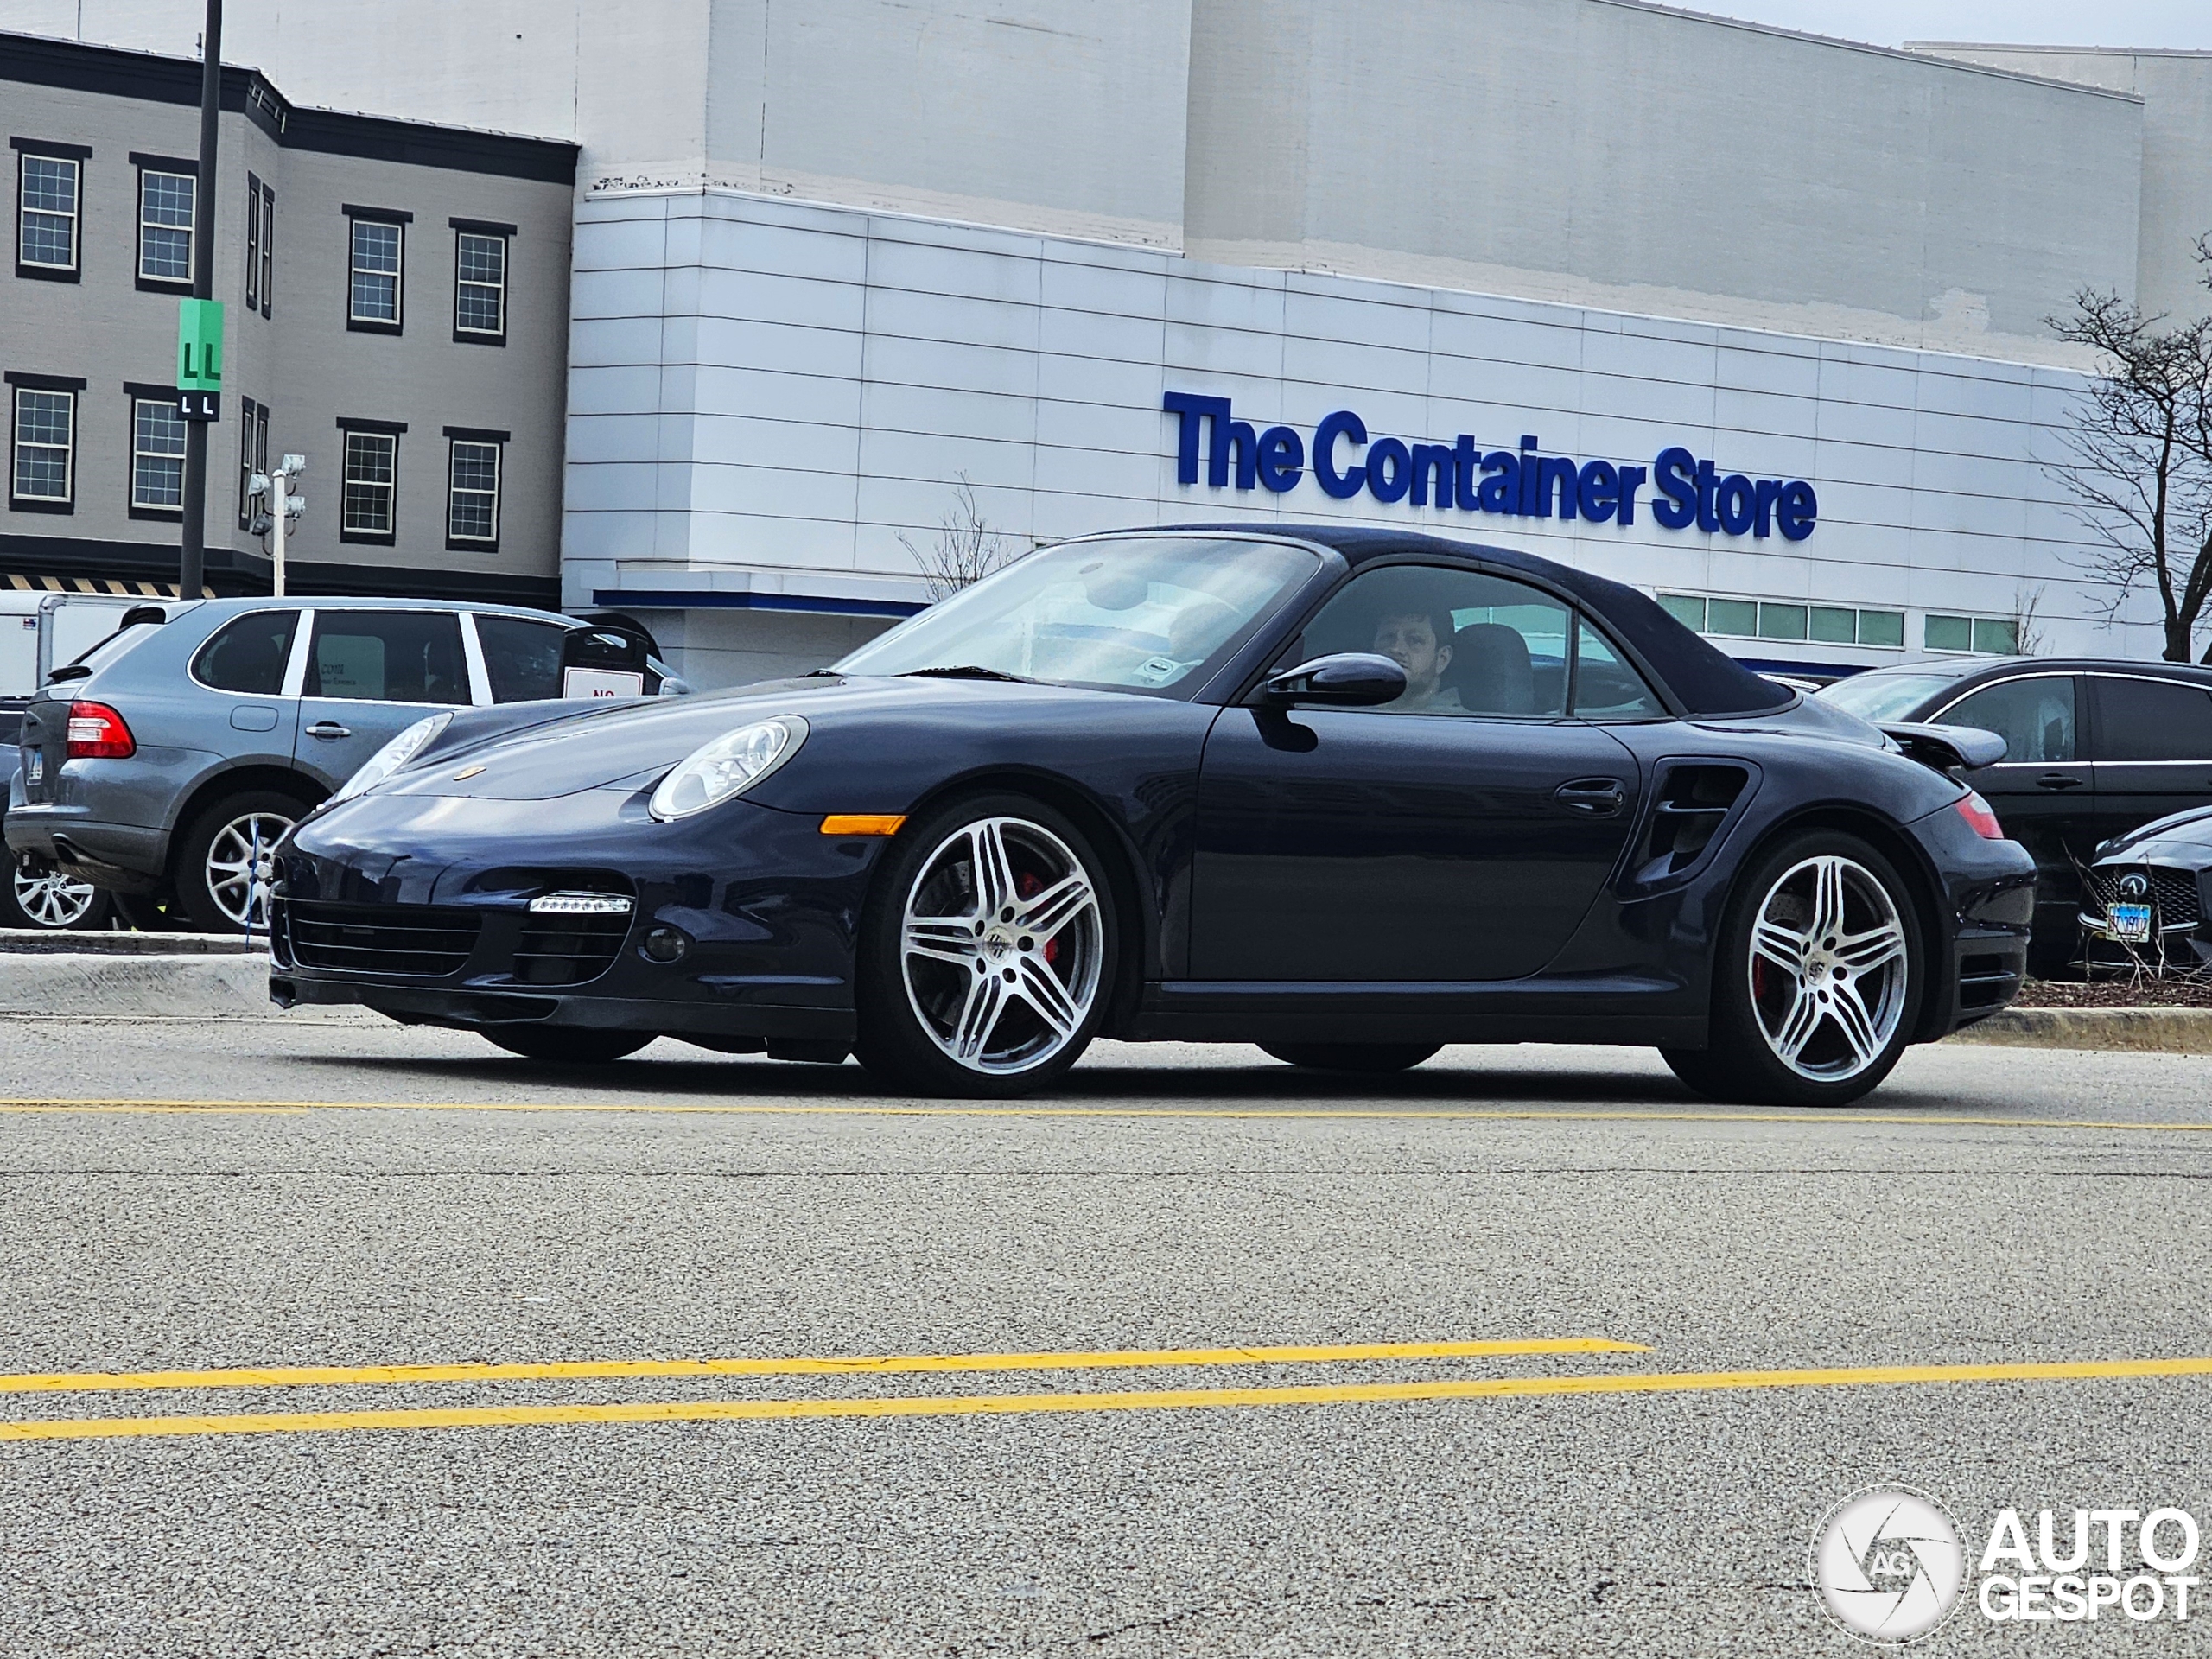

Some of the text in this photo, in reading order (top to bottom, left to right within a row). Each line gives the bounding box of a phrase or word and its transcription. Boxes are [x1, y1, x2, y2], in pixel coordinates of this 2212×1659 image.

[1163, 391, 1817, 541] The Container Store
